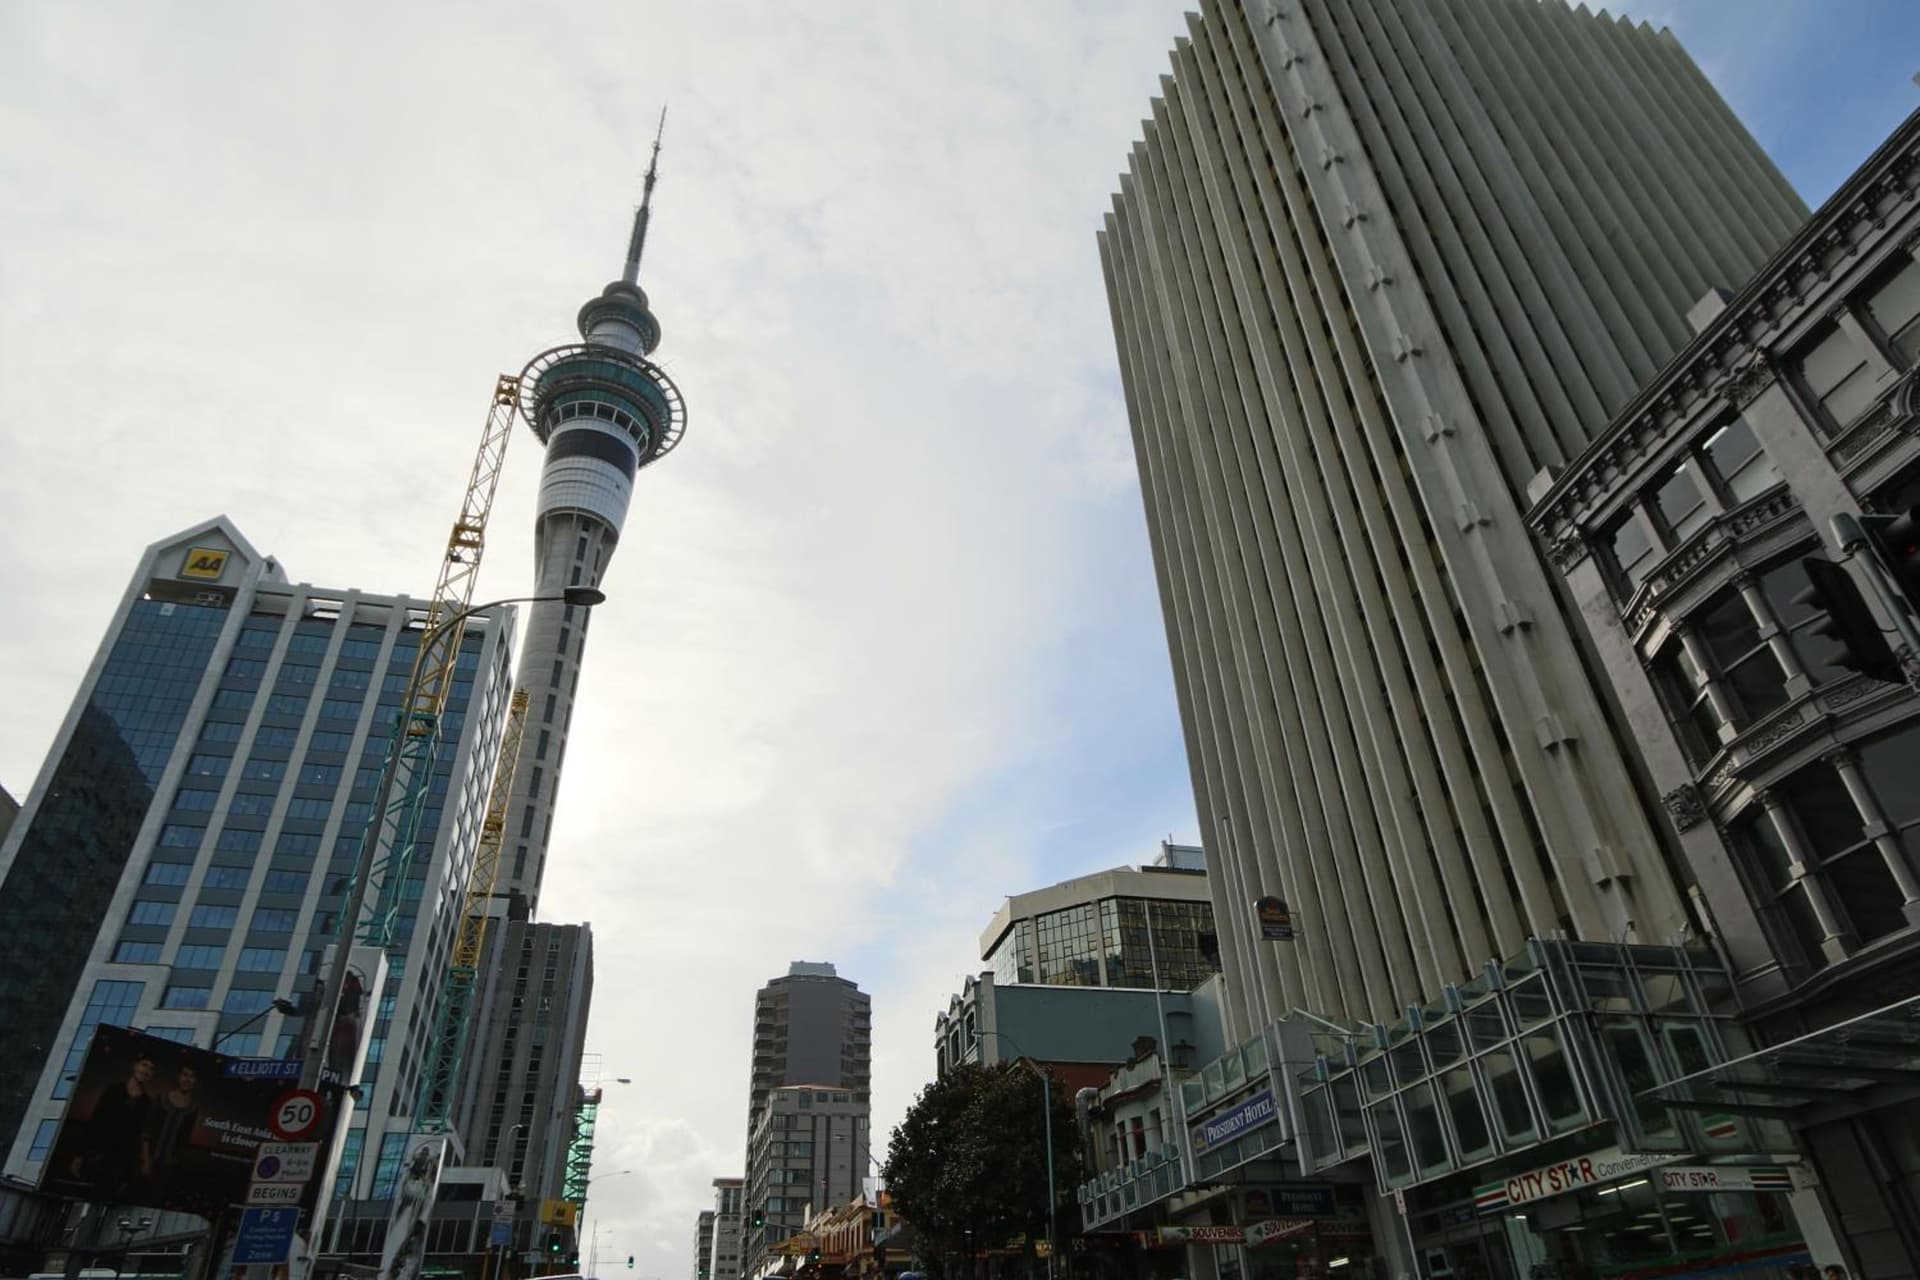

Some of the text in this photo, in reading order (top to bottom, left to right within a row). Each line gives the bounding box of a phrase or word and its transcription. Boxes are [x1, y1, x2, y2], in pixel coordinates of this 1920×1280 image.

[238, 1061, 299, 1075] ELLIOTT ST
[281, 1104, 312, 1124] 50
[1206, 1098, 1274, 1144] PRESIDENT HOTEL
[204, 1117, 231, 1131] South
[1507, 1171, 1545, 1203] CITY
[1663, 1172, 1687, 1188] CITY
[253, 1187, 298, 1200] BEGINS
[1192, 1226, 1245, 1240] SOUVENIRS
